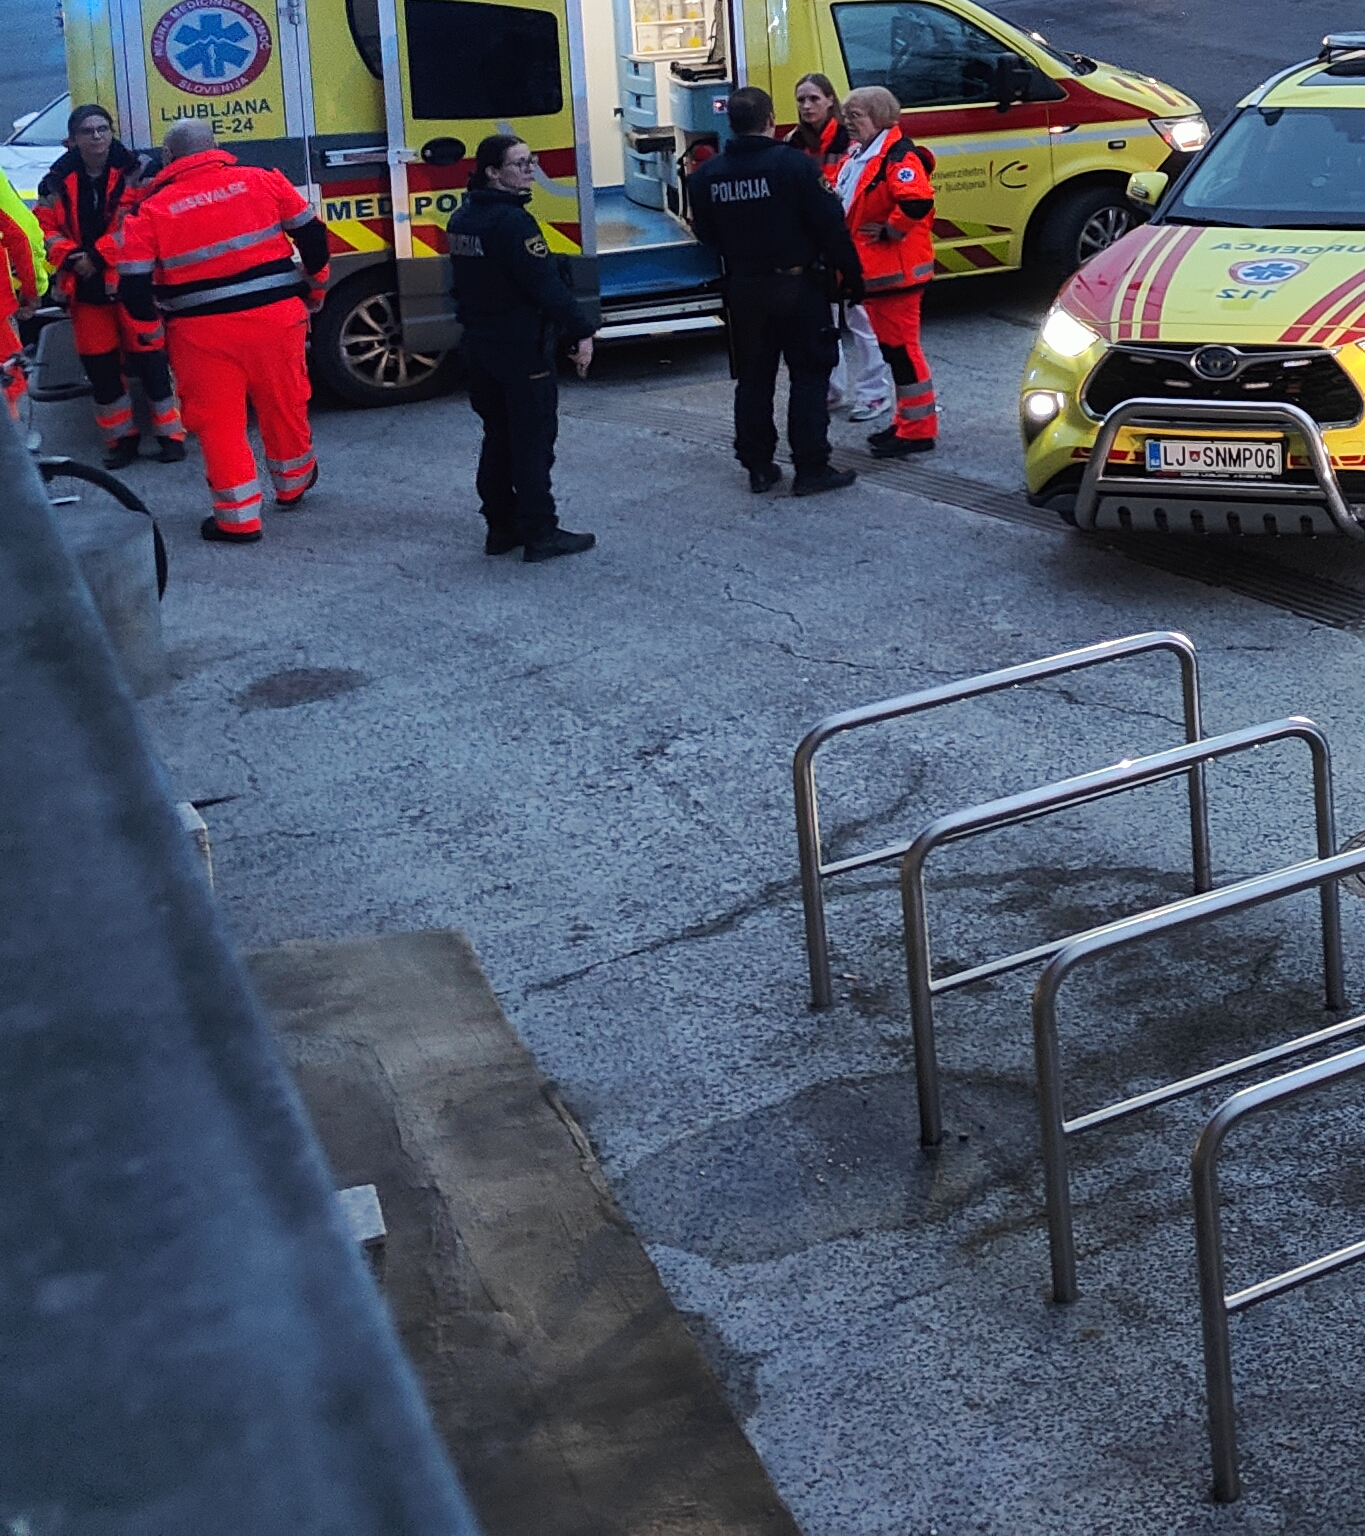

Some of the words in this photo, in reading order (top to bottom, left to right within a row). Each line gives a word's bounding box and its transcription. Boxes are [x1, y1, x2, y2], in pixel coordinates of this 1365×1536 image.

[176, 76, 249, 95] SLOVENIJA
[160, 98, 273, 122] LJUBLJANA
[710, 177, 771, 203] POLICIJA
[1163, 445, 1186, 467] LJ
[1202, 446, 1276, 469] SNMP06
